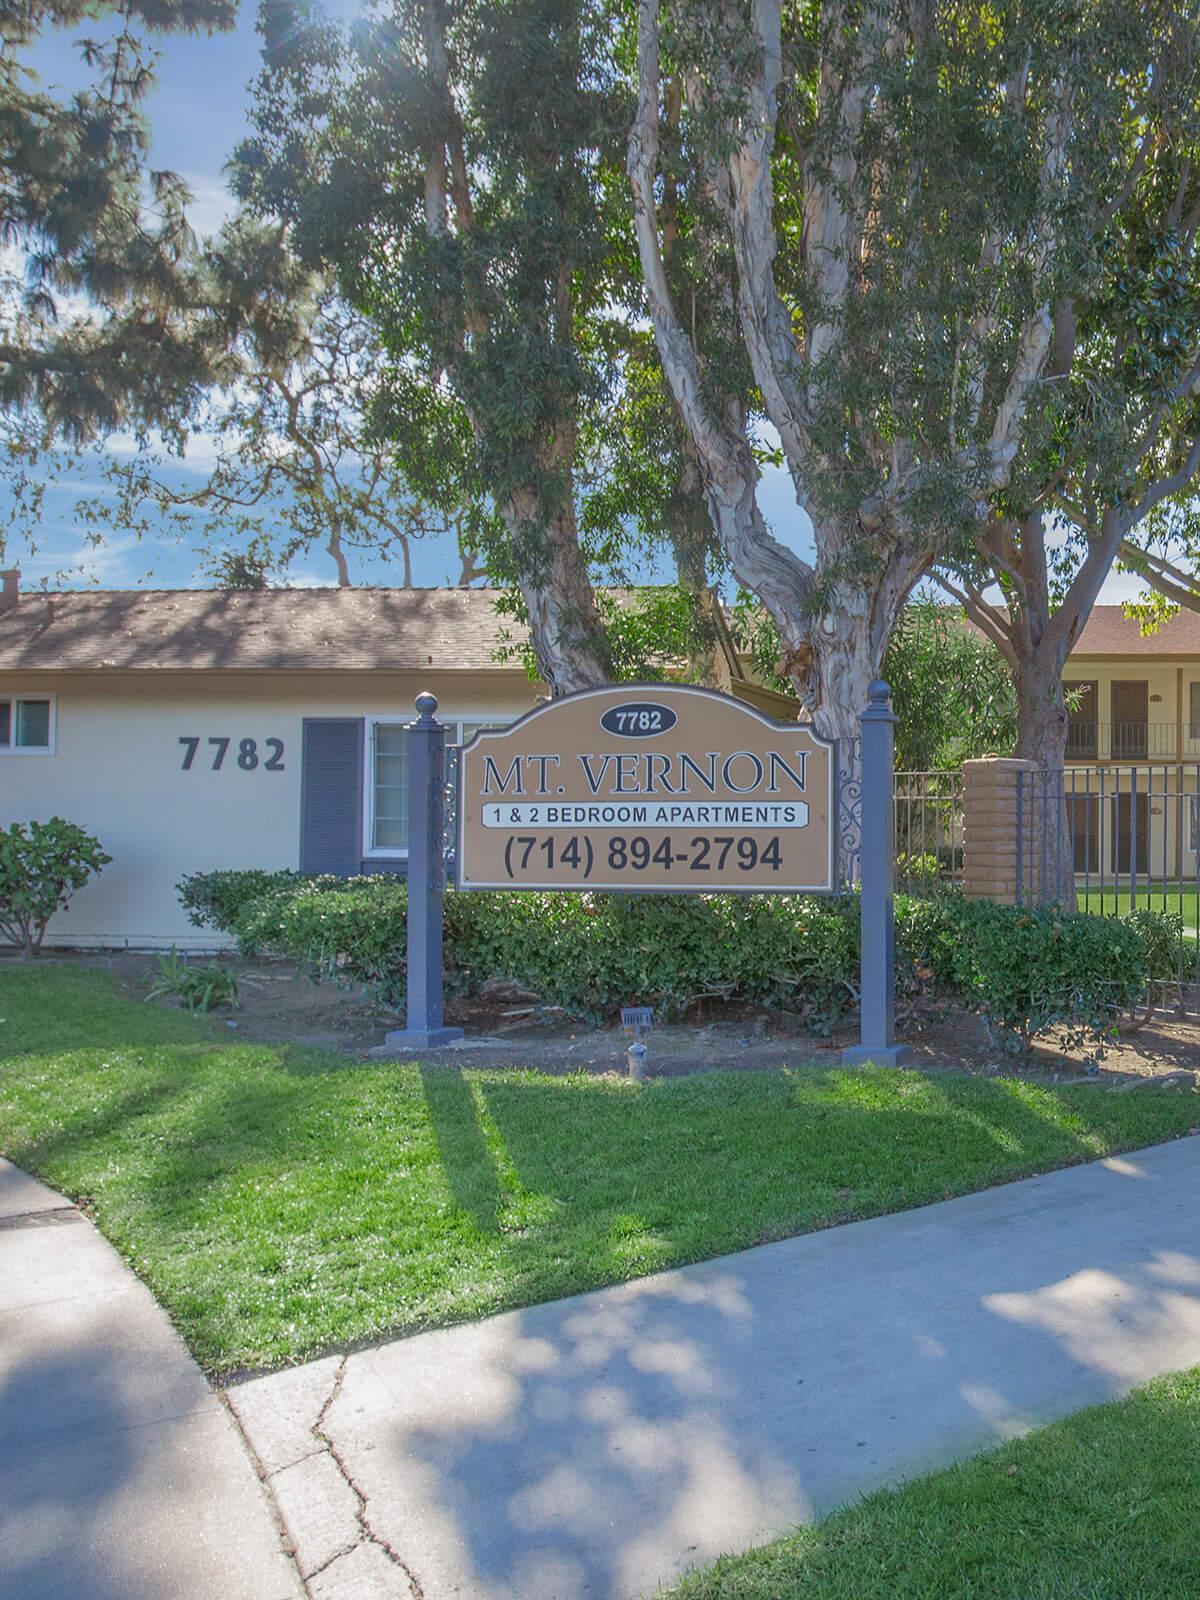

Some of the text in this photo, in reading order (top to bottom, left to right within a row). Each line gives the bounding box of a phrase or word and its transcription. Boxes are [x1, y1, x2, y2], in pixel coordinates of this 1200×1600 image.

[615, 711, 662, 731] 7782
[178, 737, 285, 771] 7782
[480, 751, 811, 796] MT. VERNON
[493, 806, 796, 823] 1 & 2 BEDROOM APARTMENTS
[504, 836, 783, 879] (714) 894-2794
